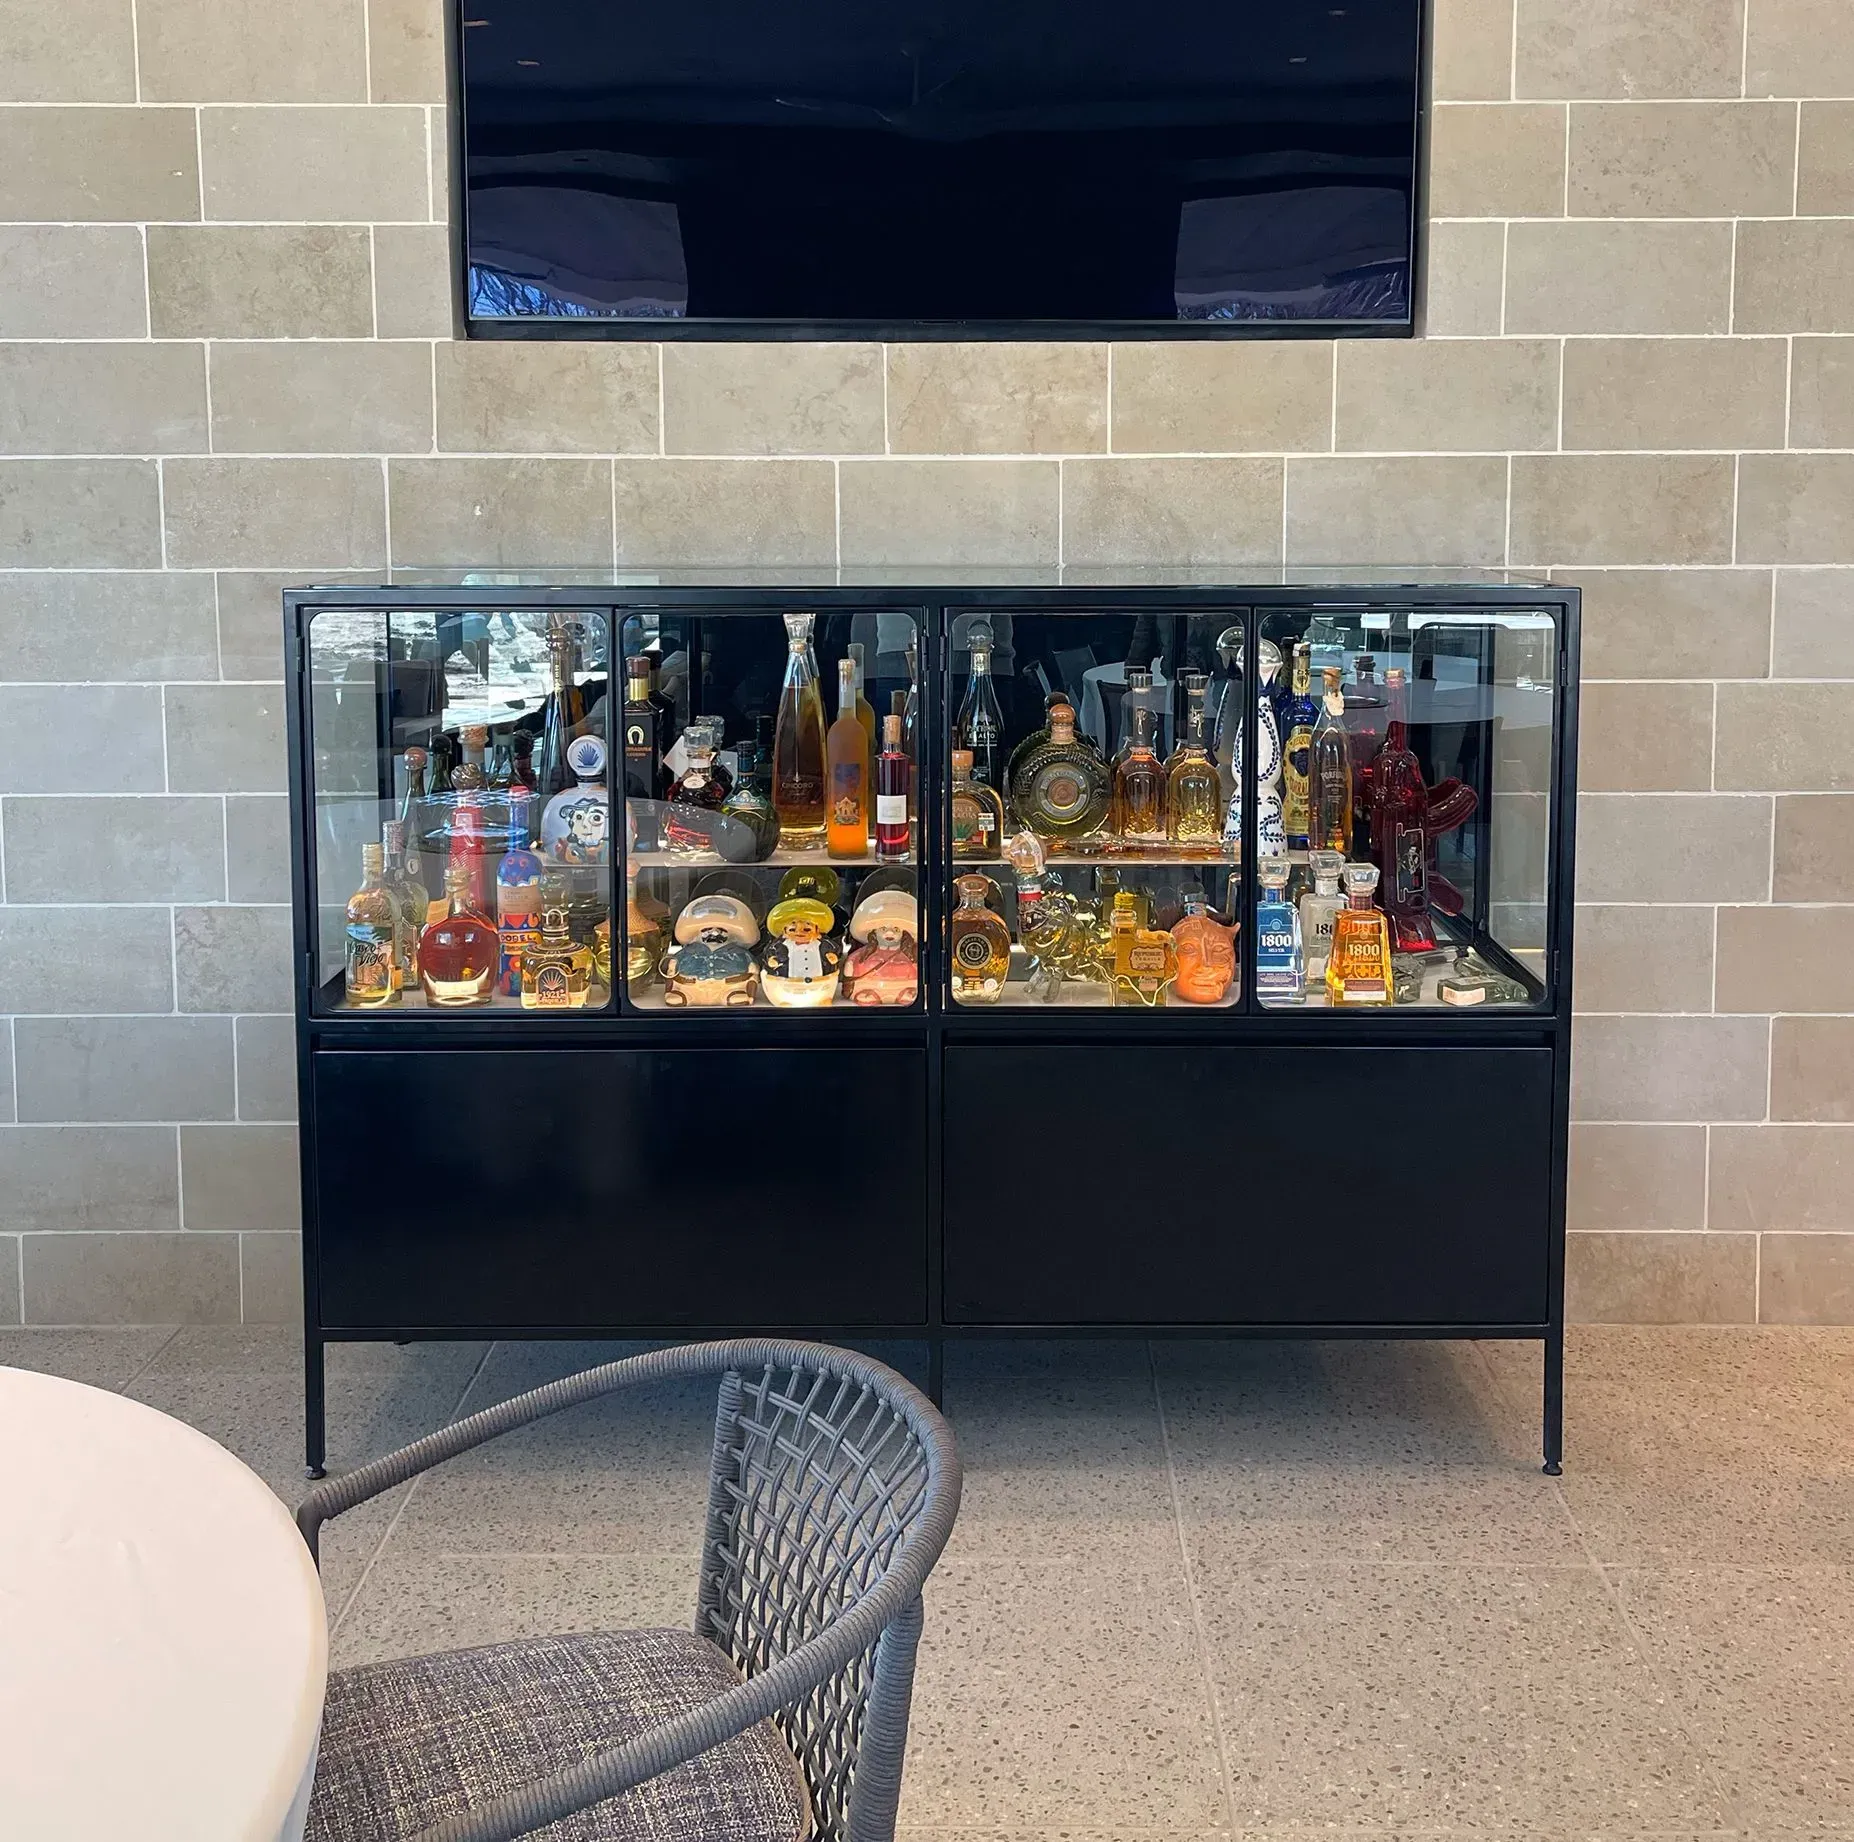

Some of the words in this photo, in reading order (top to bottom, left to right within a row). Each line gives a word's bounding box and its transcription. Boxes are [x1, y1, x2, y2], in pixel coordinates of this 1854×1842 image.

[1261, 934, 1293, 948] 1800
[1348, 943, 1380, 957] 1800
[541, 990, 561, 1000] 1921
